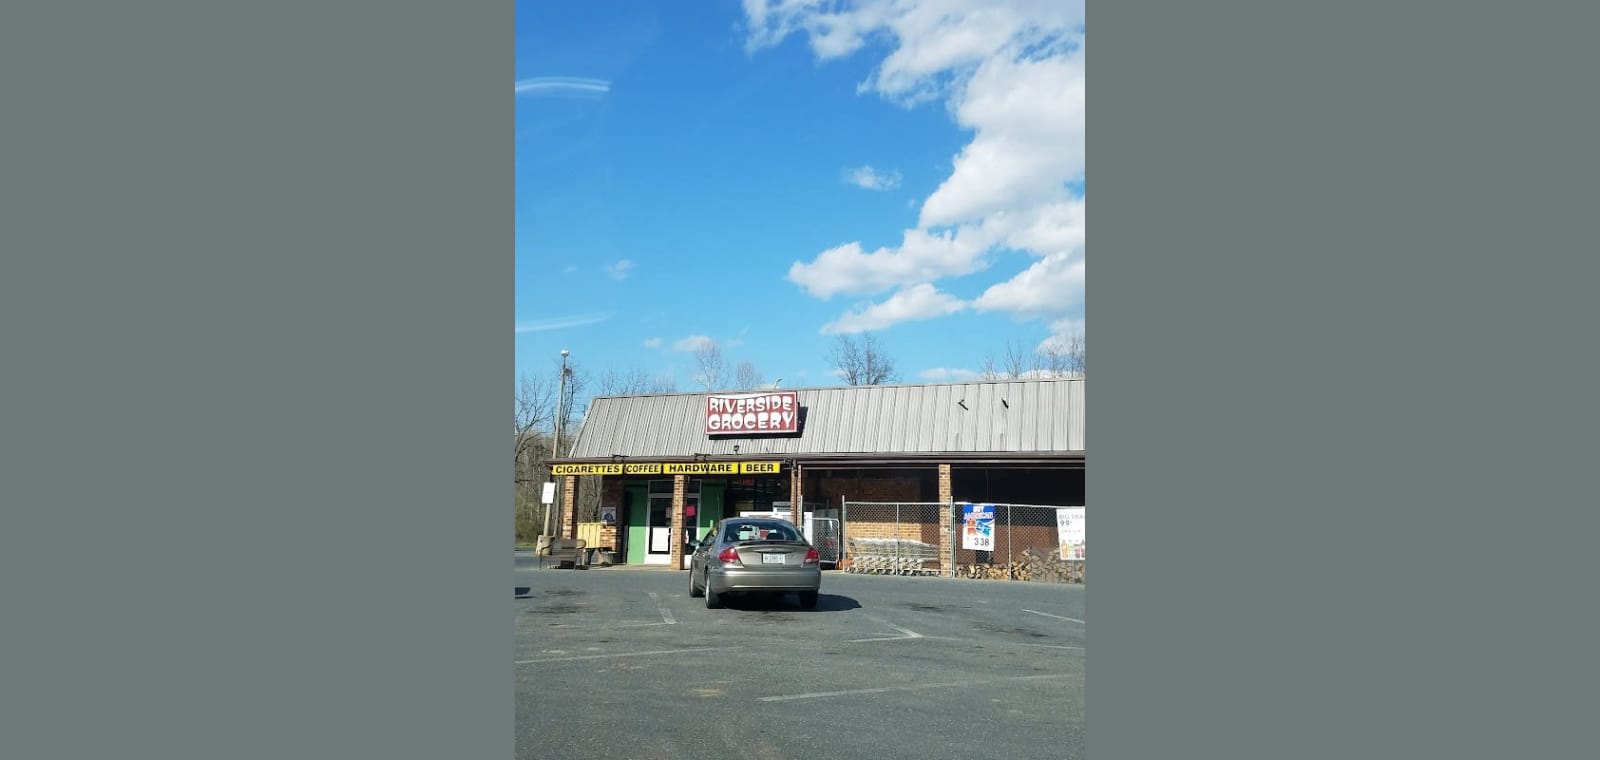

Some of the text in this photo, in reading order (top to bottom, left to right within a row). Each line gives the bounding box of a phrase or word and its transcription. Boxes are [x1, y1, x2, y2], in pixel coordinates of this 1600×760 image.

[708, 395, 792, 413] RIVERSIDE
[708, 411, 794, 430] GROCERY
[555, 464, 620, 474] CIGARETTES
[626, 464, 660, 473] COFFEE
[669, 463, 733, 473] HARDWARE
[746, 463, 774, 472] BEER
